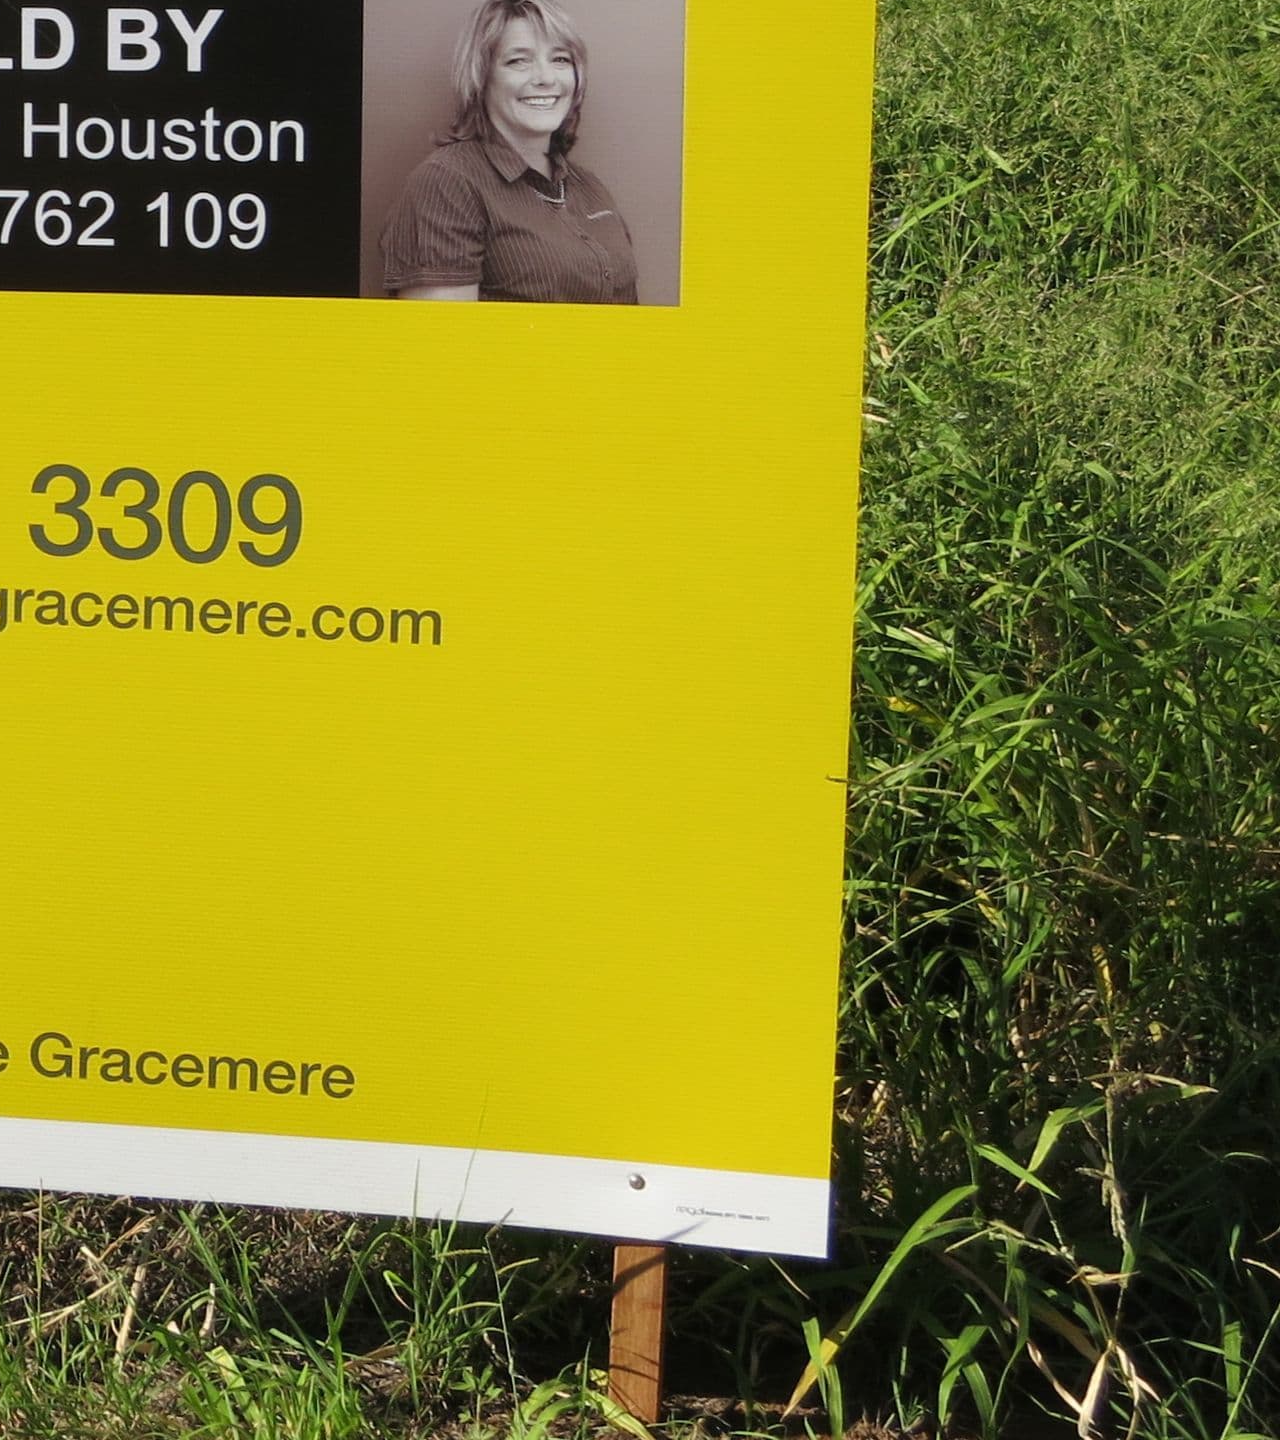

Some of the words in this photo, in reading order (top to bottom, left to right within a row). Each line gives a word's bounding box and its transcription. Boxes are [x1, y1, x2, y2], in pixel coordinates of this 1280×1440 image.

[107, 8, 224, 72] BY
[23, 102, 305, 162] Houston
[146, 191, 266, 250] 109
[28, 463, 303, 568] 3309
[30, 1031, 355, 1099] Gracemere
